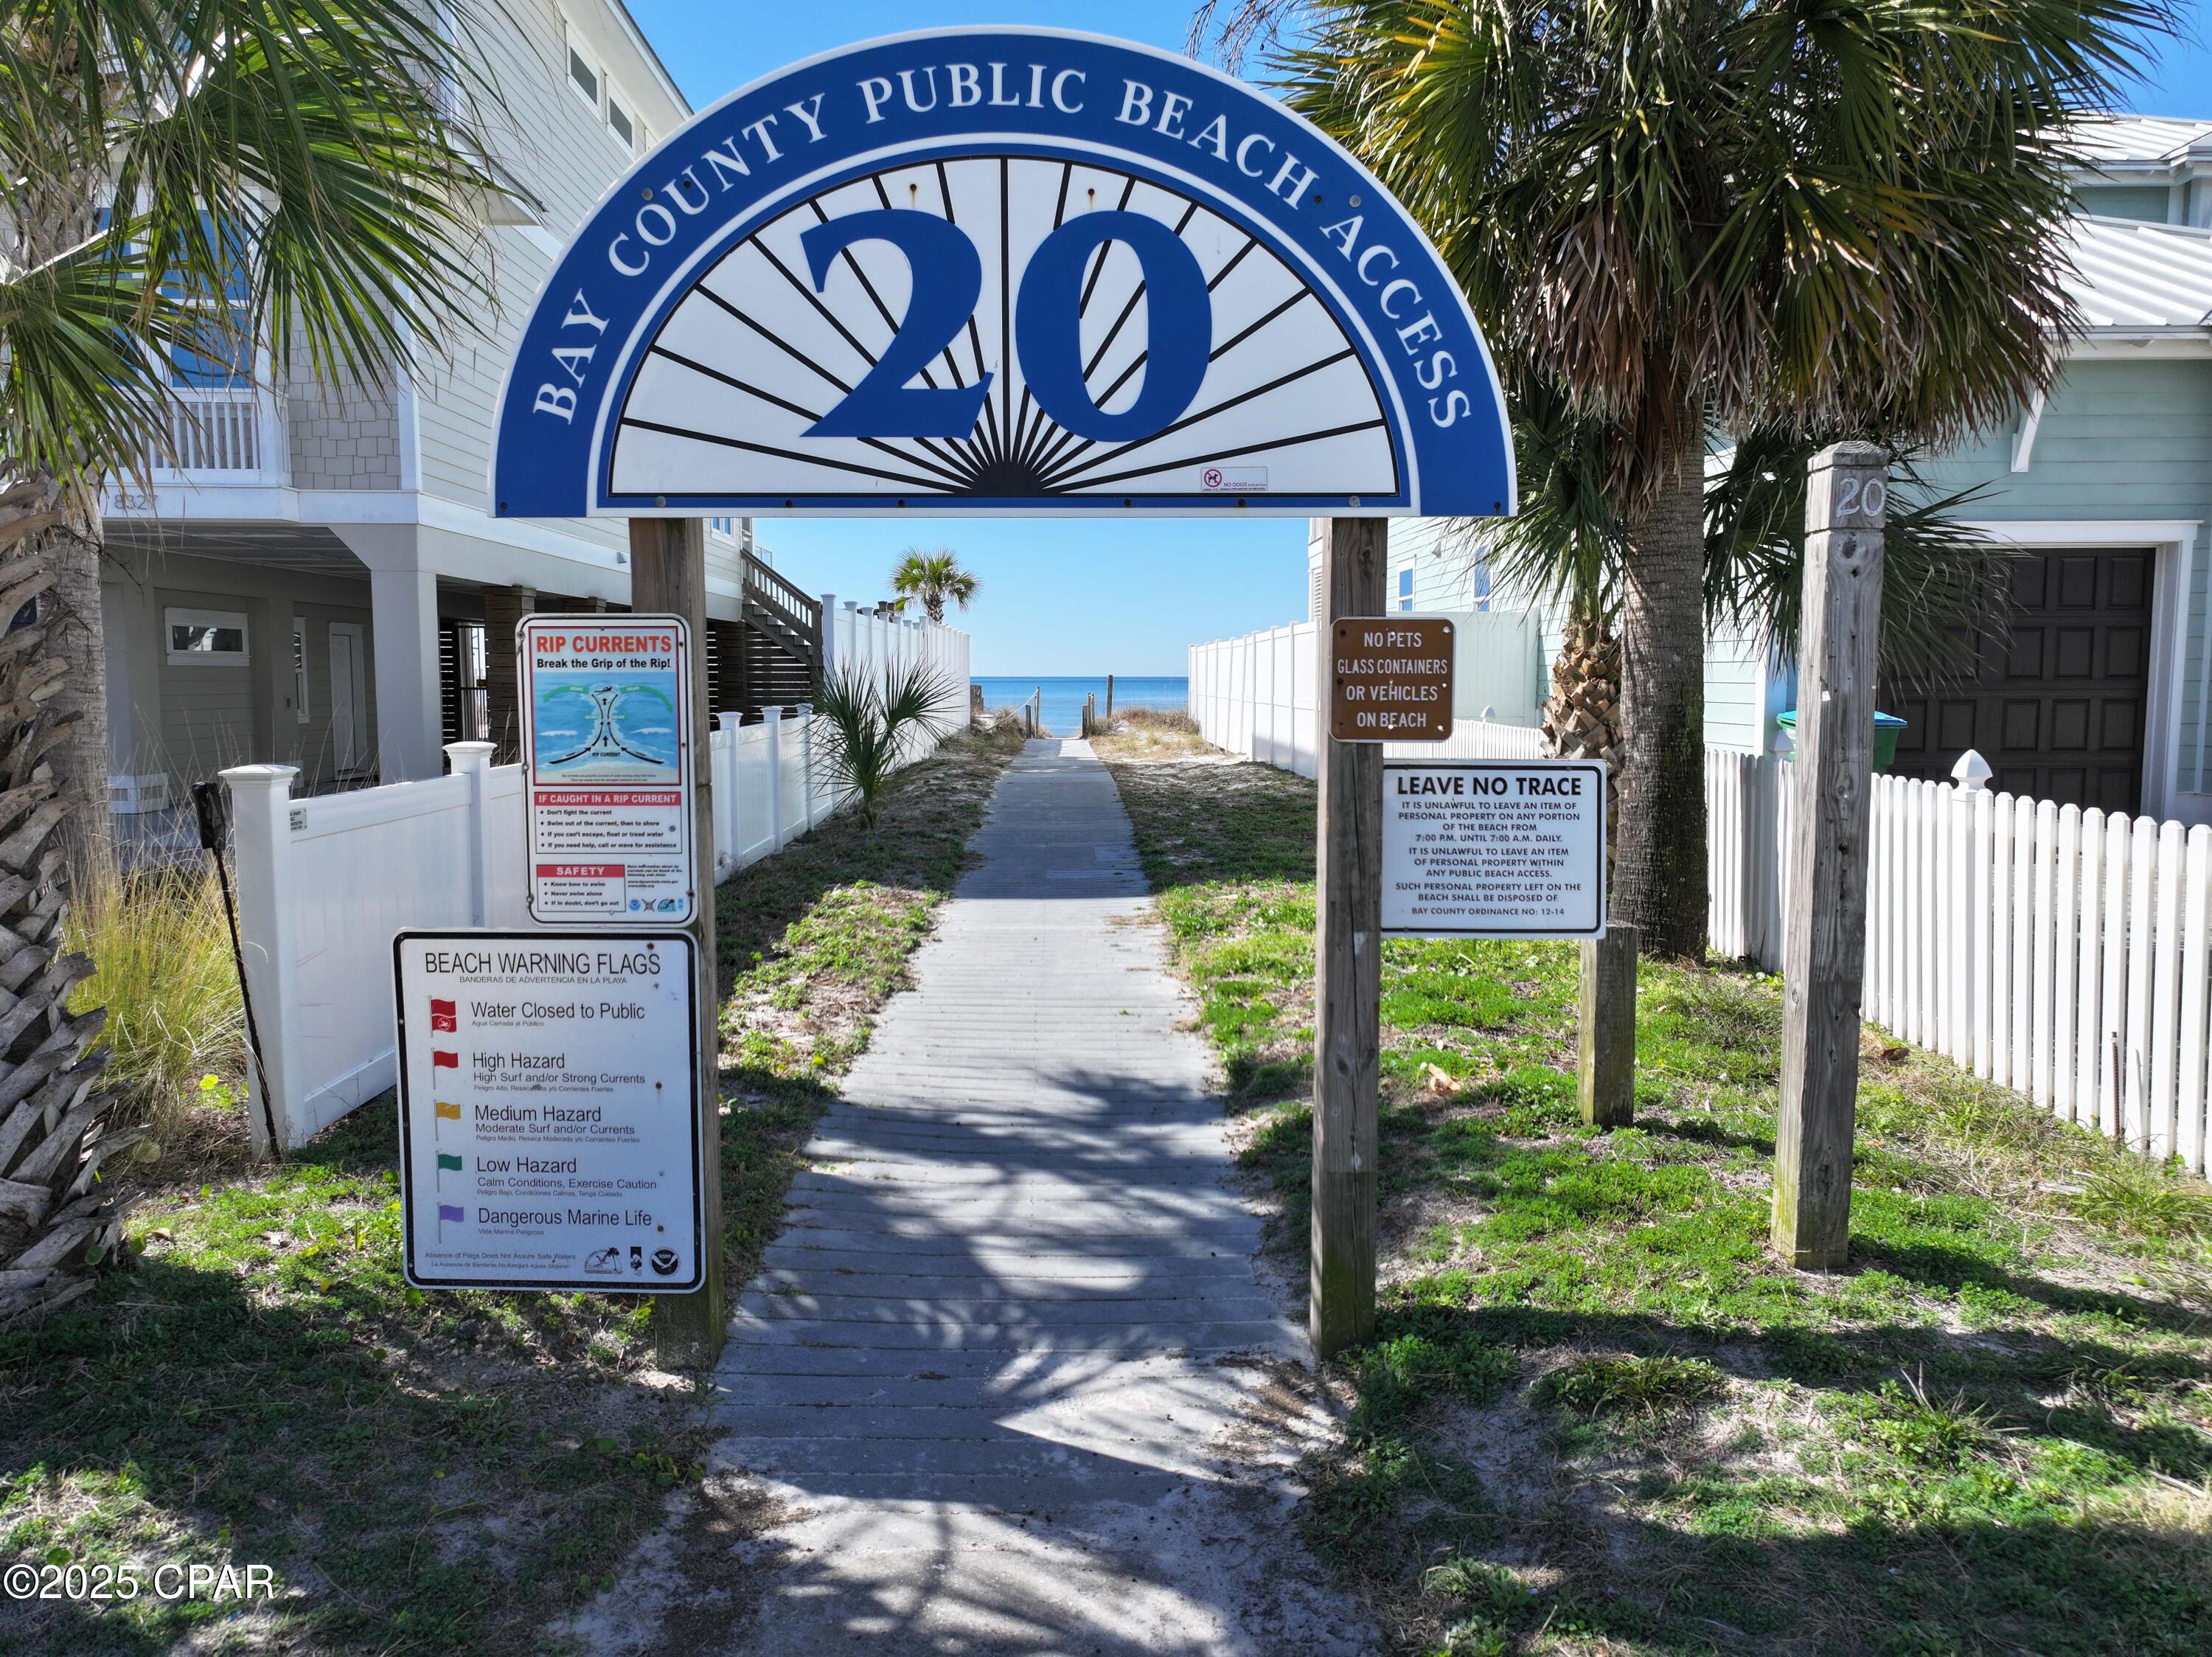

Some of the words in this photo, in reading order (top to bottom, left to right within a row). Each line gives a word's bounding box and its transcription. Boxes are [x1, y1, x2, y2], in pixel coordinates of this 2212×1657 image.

[533, 288, 610, 425] BAY
[608, 93, 828, 277] COUNTY
[856, 62, 1086, 125] PUBLIC
[1115, 79, 1319, 210] BEACH
[1319, 215, 1471, 428] ACCESS
[799, 208, 1212, 443] 20
[1835, 477, 1887, 517] 20
[537, 636, 566, 652] RIP
[572, 636, 671, 652] CURRENTS
[1364, 632, 1382, 647] NO
[1388, 631, 1421, 647] PETS
[536, 658, 568, 668] Break
[570, 658, 588, 668] the
[591, 658, 612, 670] Grip
[616, 658, 626, 667] of
[630, 658, 646, 667] the
[650, 659, 670, 670] Rip!
[1338, 659, 1374, 673] GLASS
[1377, 659, 1447, 673] CONTAINERS
[1346, 685, 1365, 700] OR
[1369, 685, 1437, 701] VEHICLES
[1357, 712, 1375, 726] ON
[1380, 712, 1426, 727] BEACH
[1398, 777, 1463, 794] LEAVE
[1473, 777, 1507, 795] NO
[1516, 777, 1580, 796] TRACE
[538, 793, 547, 803] IF
[549, 794, 589, 803] CAUGHT
[591, 794, 602, 803] IN
[603, 794, 611, 803] A
[613, 793, 629, 803] RIP
[630, 794, 676, 803] CURRENT
[1402, 801, 1411, 809] IT
[1413, 801, 1422, 809] IS
[1424, 801, 1476, 810] UNLAWFUL
[1478, 802, 1491, 810] TO
[1493, 802, 1521, 810] LEAVE
[1523, 802, 1537, 810] AN
[1540, 802, 1562, 810] ITEM
[1563, 802, 1576, 810] OF
[1398, 811, 1447, 820] PERSONAL
[1450, 812, 1496, 821] PROPERTY
[1498, 812, 1514, 820] ON
[1516, 812, 1536, 821] ANY
[1538, 812, 1580, 821] PORTION
[1441, 822, 1455, 831] OF
[1458, 823, 1475, 831] THE
[1478, 823, 1508, 831] BEACH
[1510, 823, 1537, 832] FROM
[1415, 833, 1436, 842] 7:00
[1459, 834, 1487, 842] UNTIL
[1489, 834, 1510, 842] 7:00
[1512, 834, 1532, 842] A.M.
[1535, 834, 1562, 842] DAILY.
[1408, 847, 1417, 855] IT
[1419, 847, 1429, 855] IS
[1431, 847, 1483, 855] UNLAWFUL
[1485, 847, 1498, 855] TO
[1500, 847, 1528, 855] LEAVE
[1530, 847, 1545, 855] AN
[1547, 847, 1569, 855] ITEM
[1413, 858, 1427, 866] OF
[1429, 858, 1478, 866] PERSONAL
[1481, 858, 1527, 866] PROPERTY
[1528, 858, 1564, 866] WITHIN
[556, 866, 605, 875] SAFETY
[1425, 869, 1446, 877] ANY
[1448, 869, 1481, 878] PUBLIC
[1484, 869, 1514, 878] BEACH
[1516, 869, 1552, 878] ACCESS.
[1395, 882, 1421, 890] SUCH
[1423, 882, 1473, 891] PERSONAL
[1475, 883, 1522, 891] PROPERTY
[1523, 883, 1544, 892] LEFT
[1546, 883, 1562, 891] ON
[1563, 883, 1581, 891] THE
[1418, 893, 1449, 901] BEACH
[1451, 893, 1481, 902] SHALL
[1483, 894, 1495, 902] BE
[1497, 894, 1543, 902] DISPOSED
[1430, 907, 1466, 915] COUNTY
[1521, 907, 1538, 915] NO:
[425, 952, 490, 973] BEACH
[498, 953, 589, 973] WARNING
[597, 953, 660, 974] FLAGS
[459, 976, 504, 984] BANDERAS
[505, 976, 517, 984] DE
[518, 976, 575, 984] ADVERTENCIA
[577, 976, 588, 984] EN
[602, 976, 627, 984] PLAYA
[471, 1001, 516, 1018] Water
[521, 1001, 574, 1018] Closed
[580, 1004, 594, 1018] to
[600, 1003, 644, 1018] Public
[473, 1052, 505, 1071] High
[511, 1052, 565, 1069] Hazard
[473, 1072, 497, 1084] High
[500, 1071, 522, 1082] Surf
[525, 1073, 558, 1083] and/or
[562, 1073, 596, 1085] Strong
[600, 1074, 644, 1083] Currents
[476, 1105, 536, 1121] Medium
[543, 1105, 600, 1122] Hazard
[475, 1123, 525, 1133] Moderate
[528, 1123, 551, 1133] Surf
[552, 1124, 587, 1134] and/or
[590, 1125, 634, 1134] Currents
[477, 1156, 510, 1172] Low
[517, 1156, 576, 1173] Hazard
[478, 1177, 504, 1187] Calm
[508, 1178, 564, 1188] Conditions,
[568, 1178, 613, 1188] Exercise
[616, 1179, 655, 1189] Caution
[479, 1208, 562, 1227] Dangerous
[568, 1209, 619, 1225] Marine
[625, 1210, 651, 1226] Life
